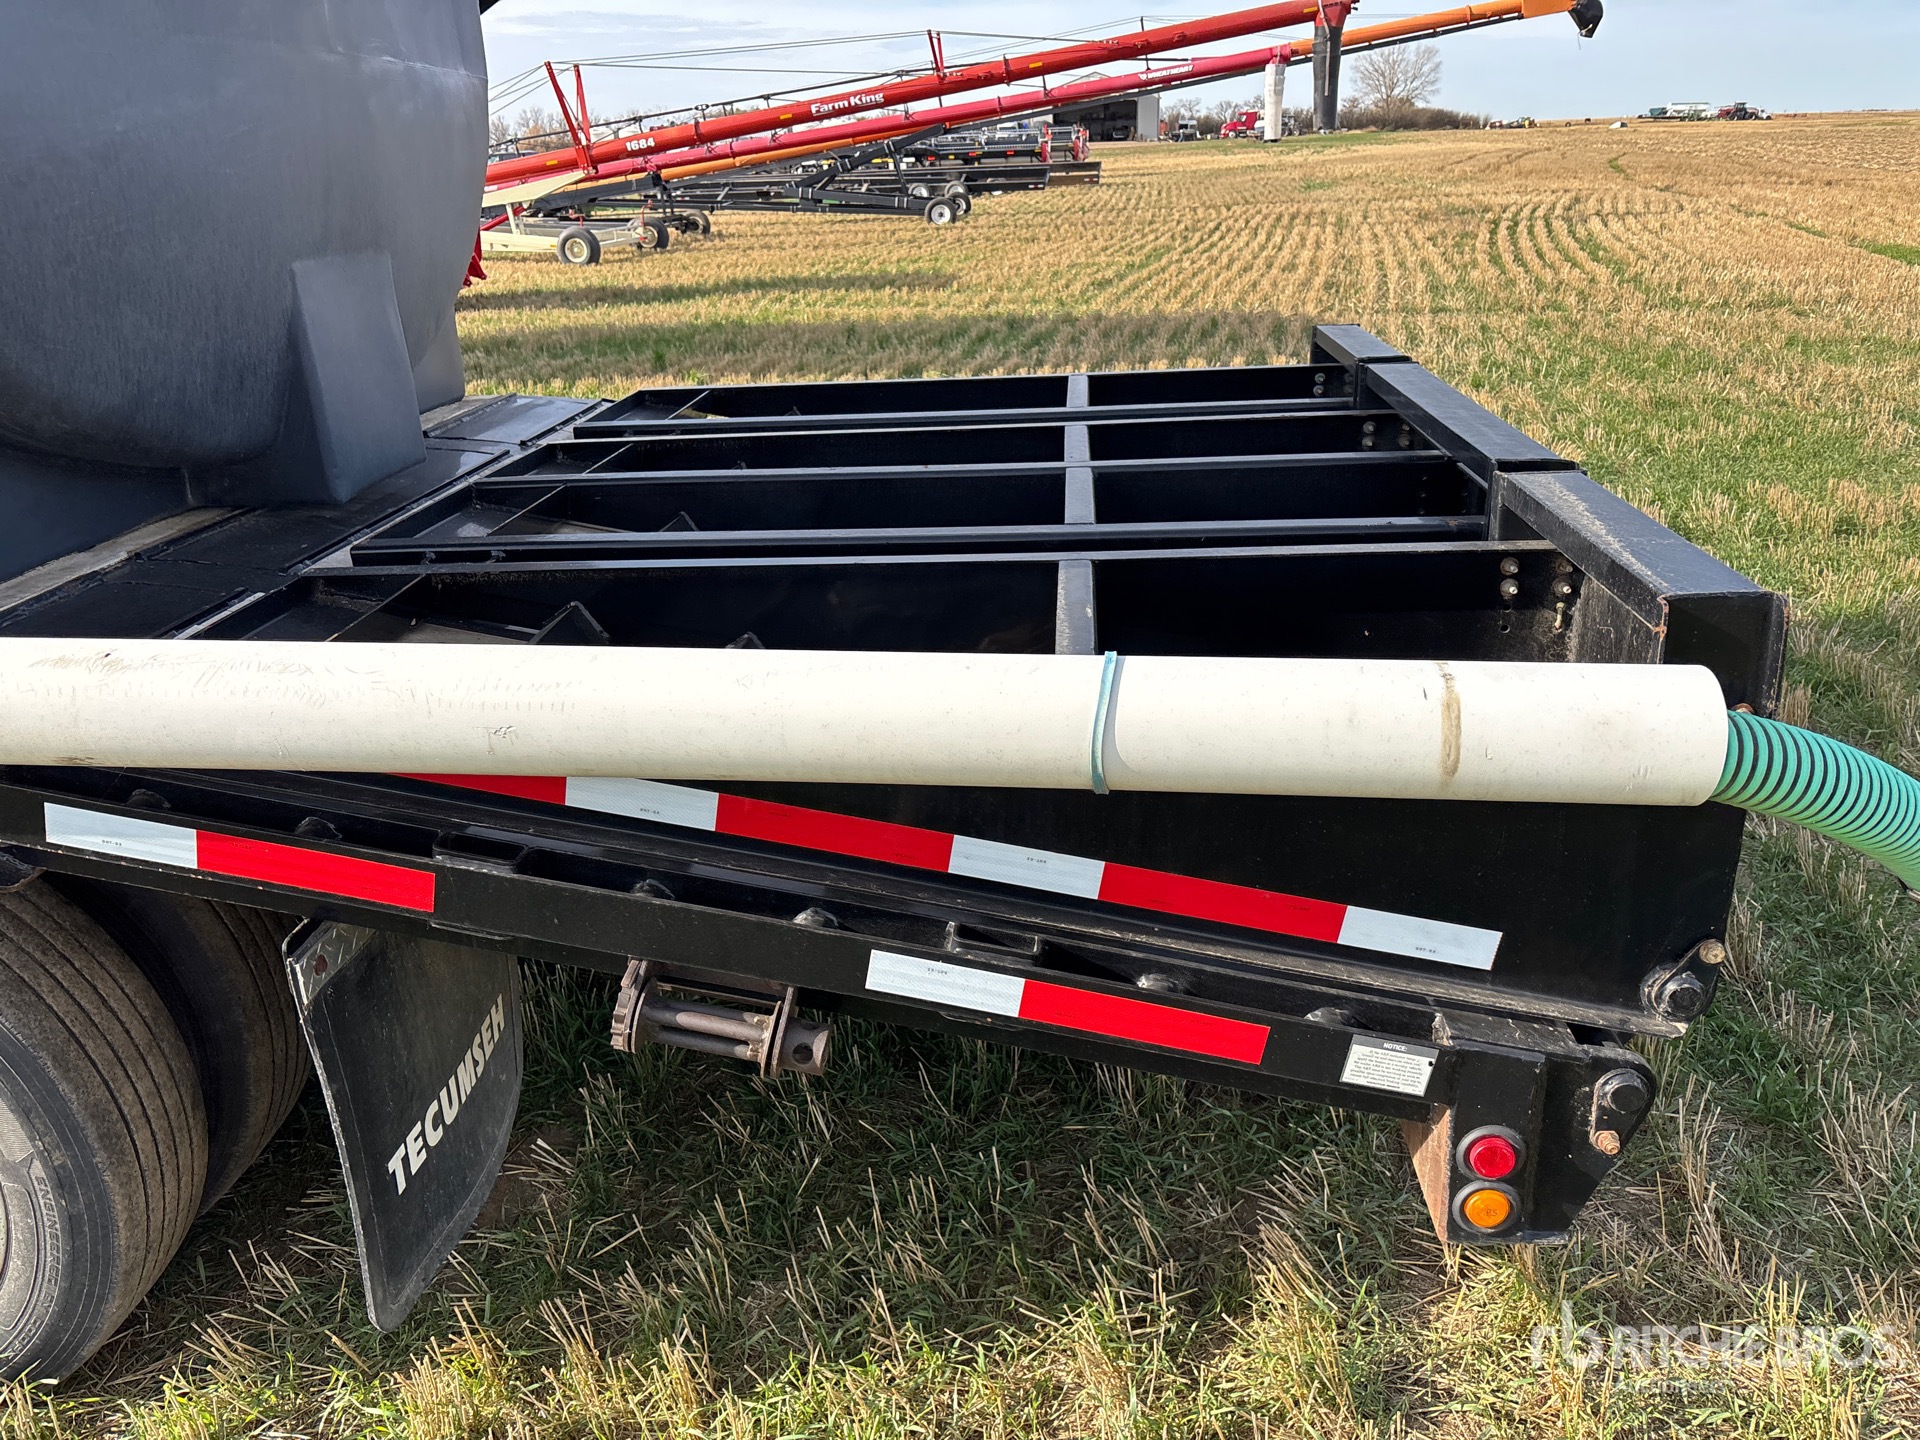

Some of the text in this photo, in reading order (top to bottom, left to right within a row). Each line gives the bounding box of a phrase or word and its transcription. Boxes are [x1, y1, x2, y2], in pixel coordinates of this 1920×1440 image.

[849, 92, 885, 106] King
[625, 137, 656, 151] 1684
[1382, 1042, 1408, 1052] NOTICE:
[387, 993, 505, 1195] TECUMSEH
